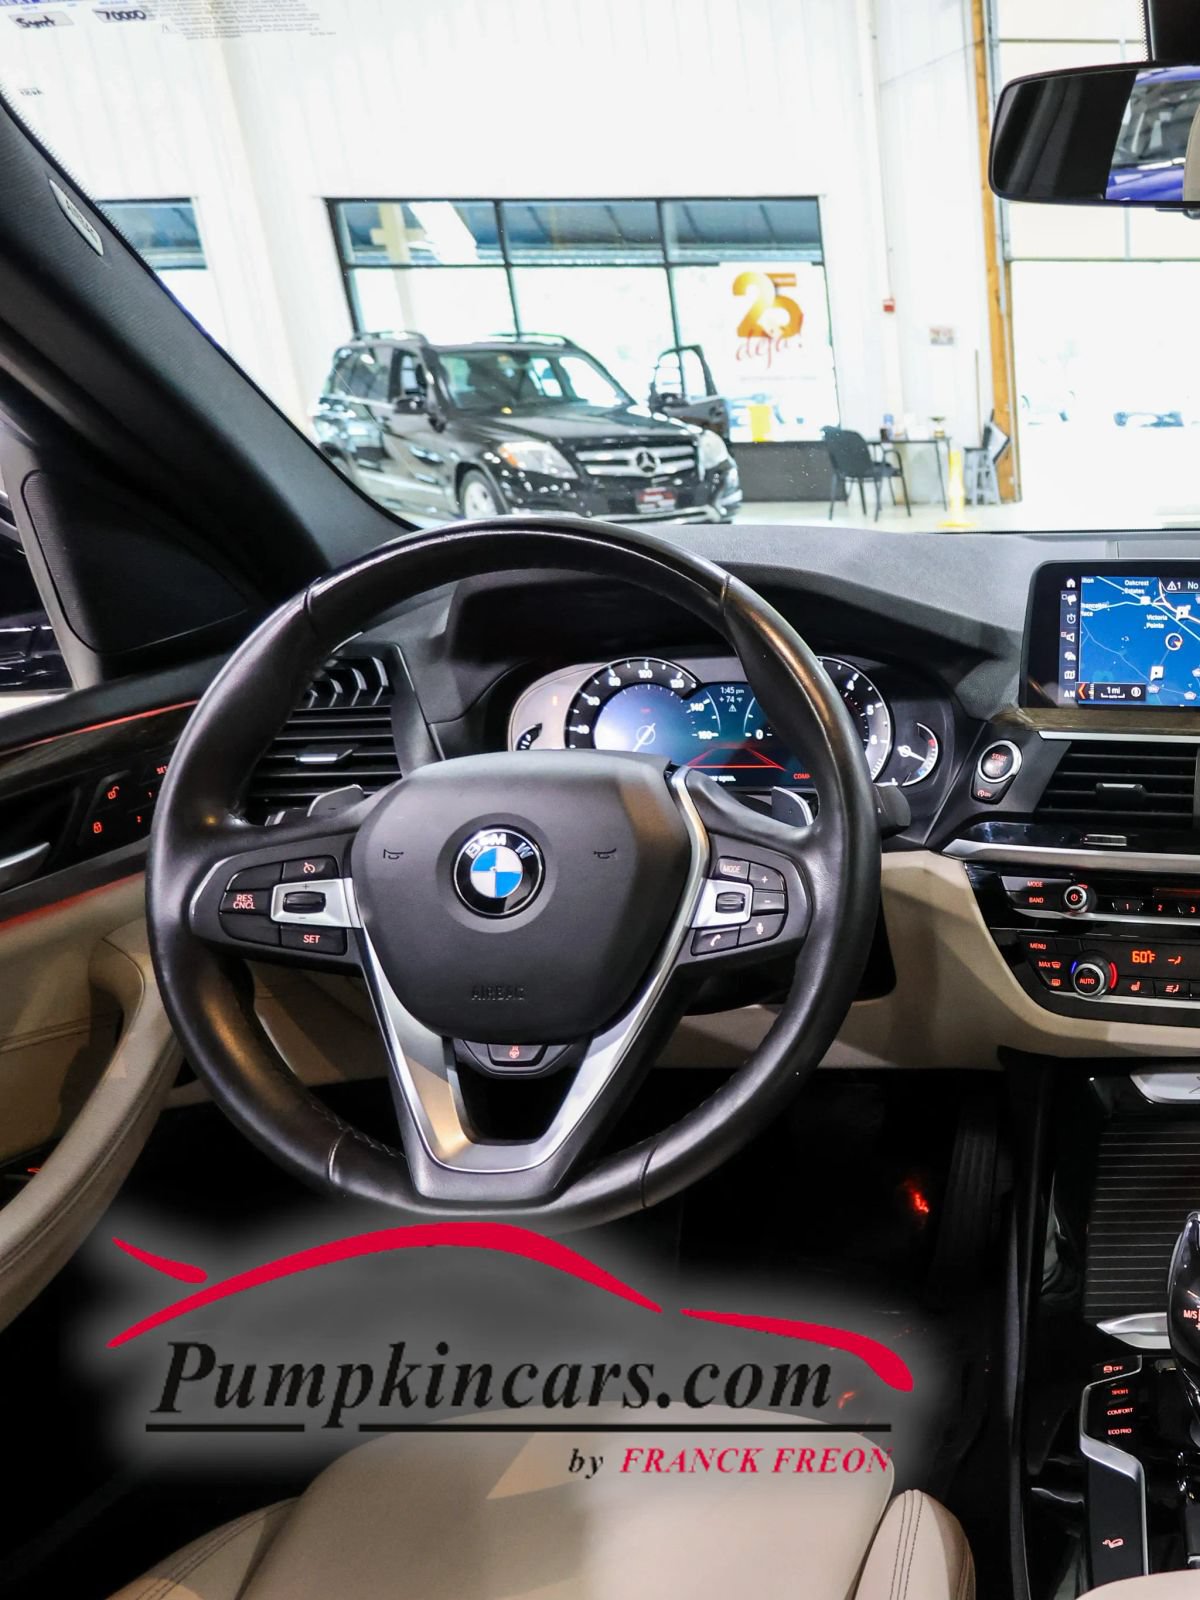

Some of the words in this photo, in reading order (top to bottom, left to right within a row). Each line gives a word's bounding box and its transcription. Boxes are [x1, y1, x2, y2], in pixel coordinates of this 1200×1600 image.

[732, 271, 804, 338] 25
[1187, 581, 1199, 590] No
[1146, 613, 1168, 621] Victoria
[637, 669, 653, 679] 100
[720, 686, 735, 694] 1:45
[846, 680, 855, 691] 4
[726, 695, 735, 703] 74
[866, 704, 874, 715] 5
[755, 728, 764, 740] 0
[991, 752, 1008, 761] START
[464, 832, 534, 860] BMW
[722, 863, 742, 873] MODE
[1026, 880, 1044, 888] MODE
[1028, 896, 1045, 904] BAND
[232, 901, 256, 910] CNCL
[303, 934, 321, 944] SET
[1029, 942, 1047, 950] MENU
[1131, 950, 1156, 964] 60°F
[1038, 961, 1051, 969] MAX
[471, 984, 525, 1001] AIRBAG
[1183, 1310, 1198, 1319] M/S
[1106, 1407, 1134, 1416] COMFORT
